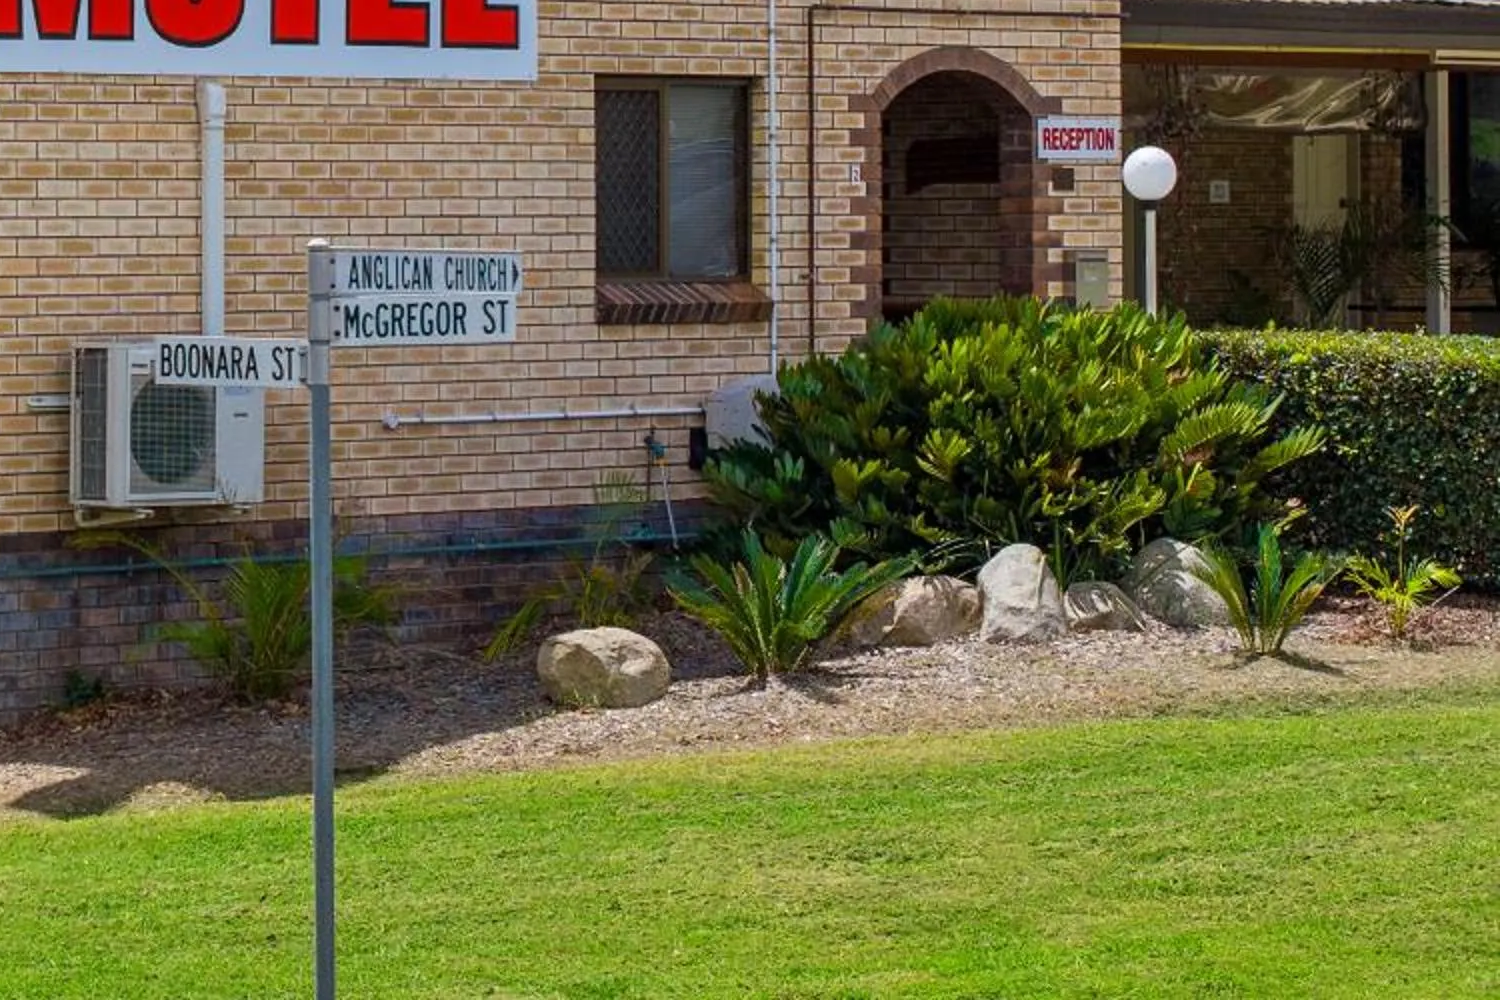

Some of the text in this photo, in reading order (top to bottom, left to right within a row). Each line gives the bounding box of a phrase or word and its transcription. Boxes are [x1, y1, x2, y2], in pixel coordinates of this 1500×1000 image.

[1042, 126, 1116, 151] RECEPTION
[348, 255, 507, 292] ANGLICAN CHURCH
[343, 299, 509, 339] McGREGOR ST
[160, 344, 294, 381] BOONARA ST
